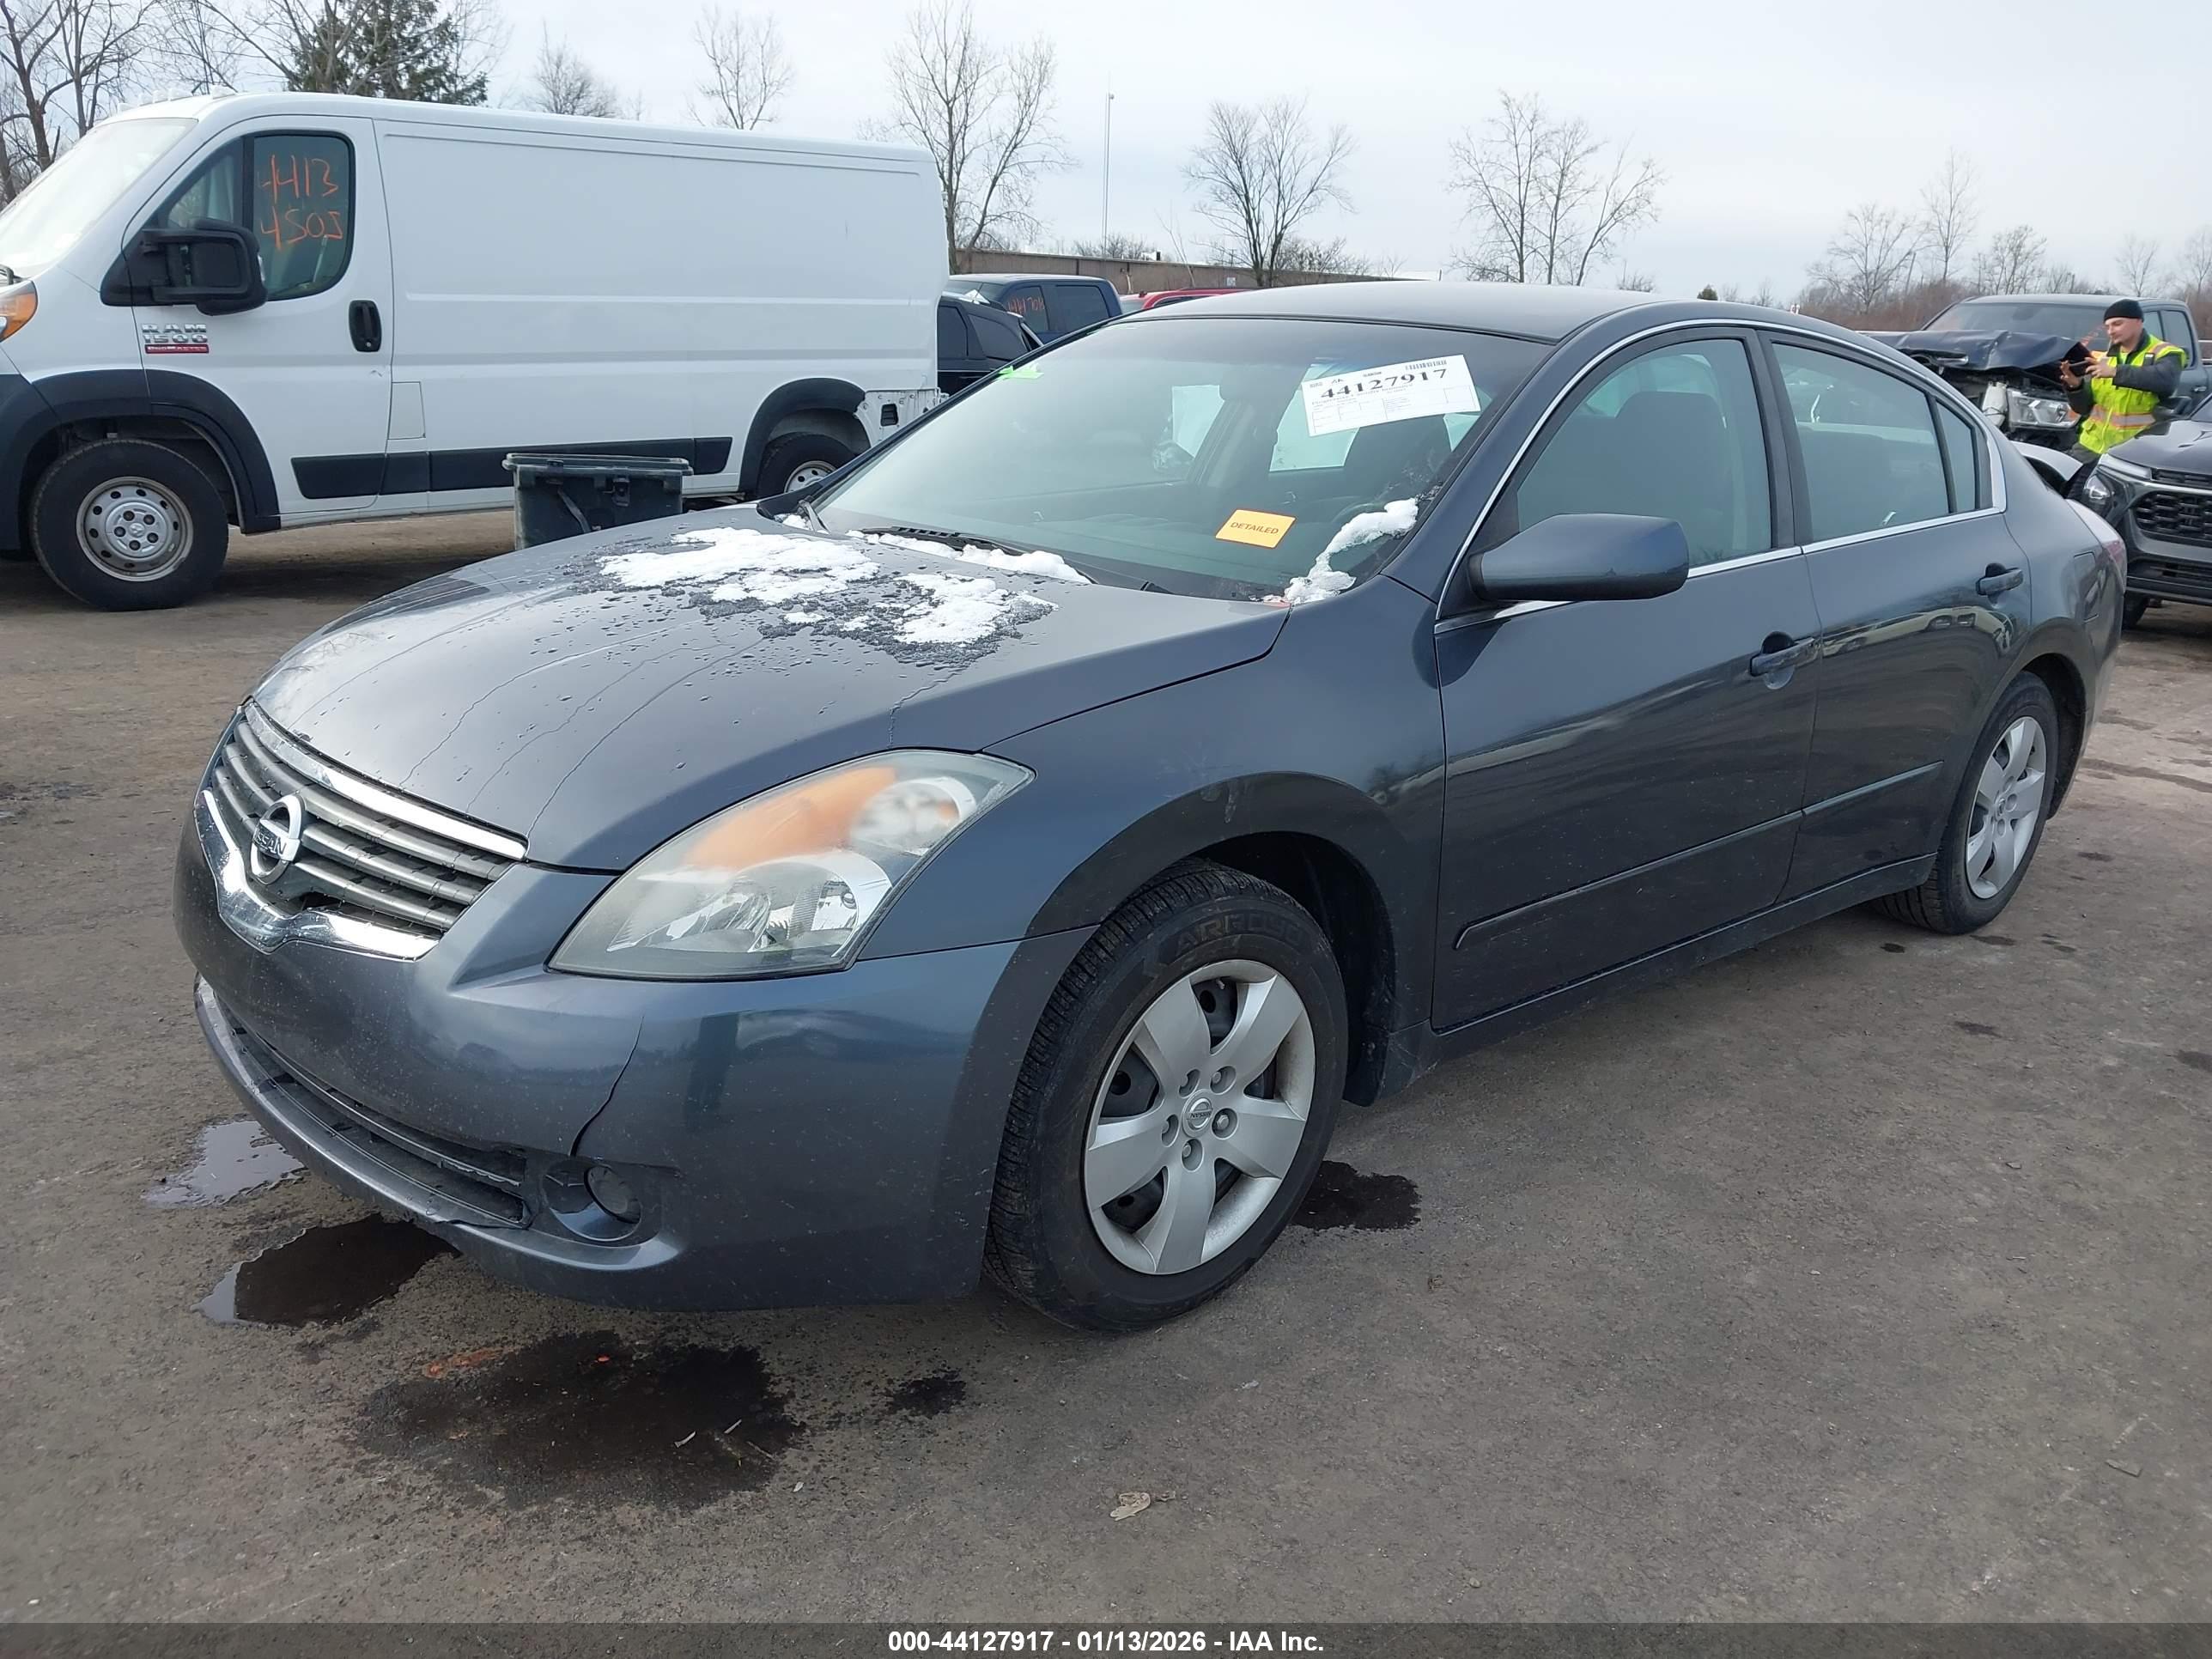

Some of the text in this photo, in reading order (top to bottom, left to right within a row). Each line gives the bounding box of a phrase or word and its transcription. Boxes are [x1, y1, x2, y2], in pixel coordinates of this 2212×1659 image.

[142, 324, 207, 333] RAM
[143, 334, 208, 343] 1500
[1321, 368, 1448, 398] 44127917
[1231, 522, 1279, 534] DETAILED
